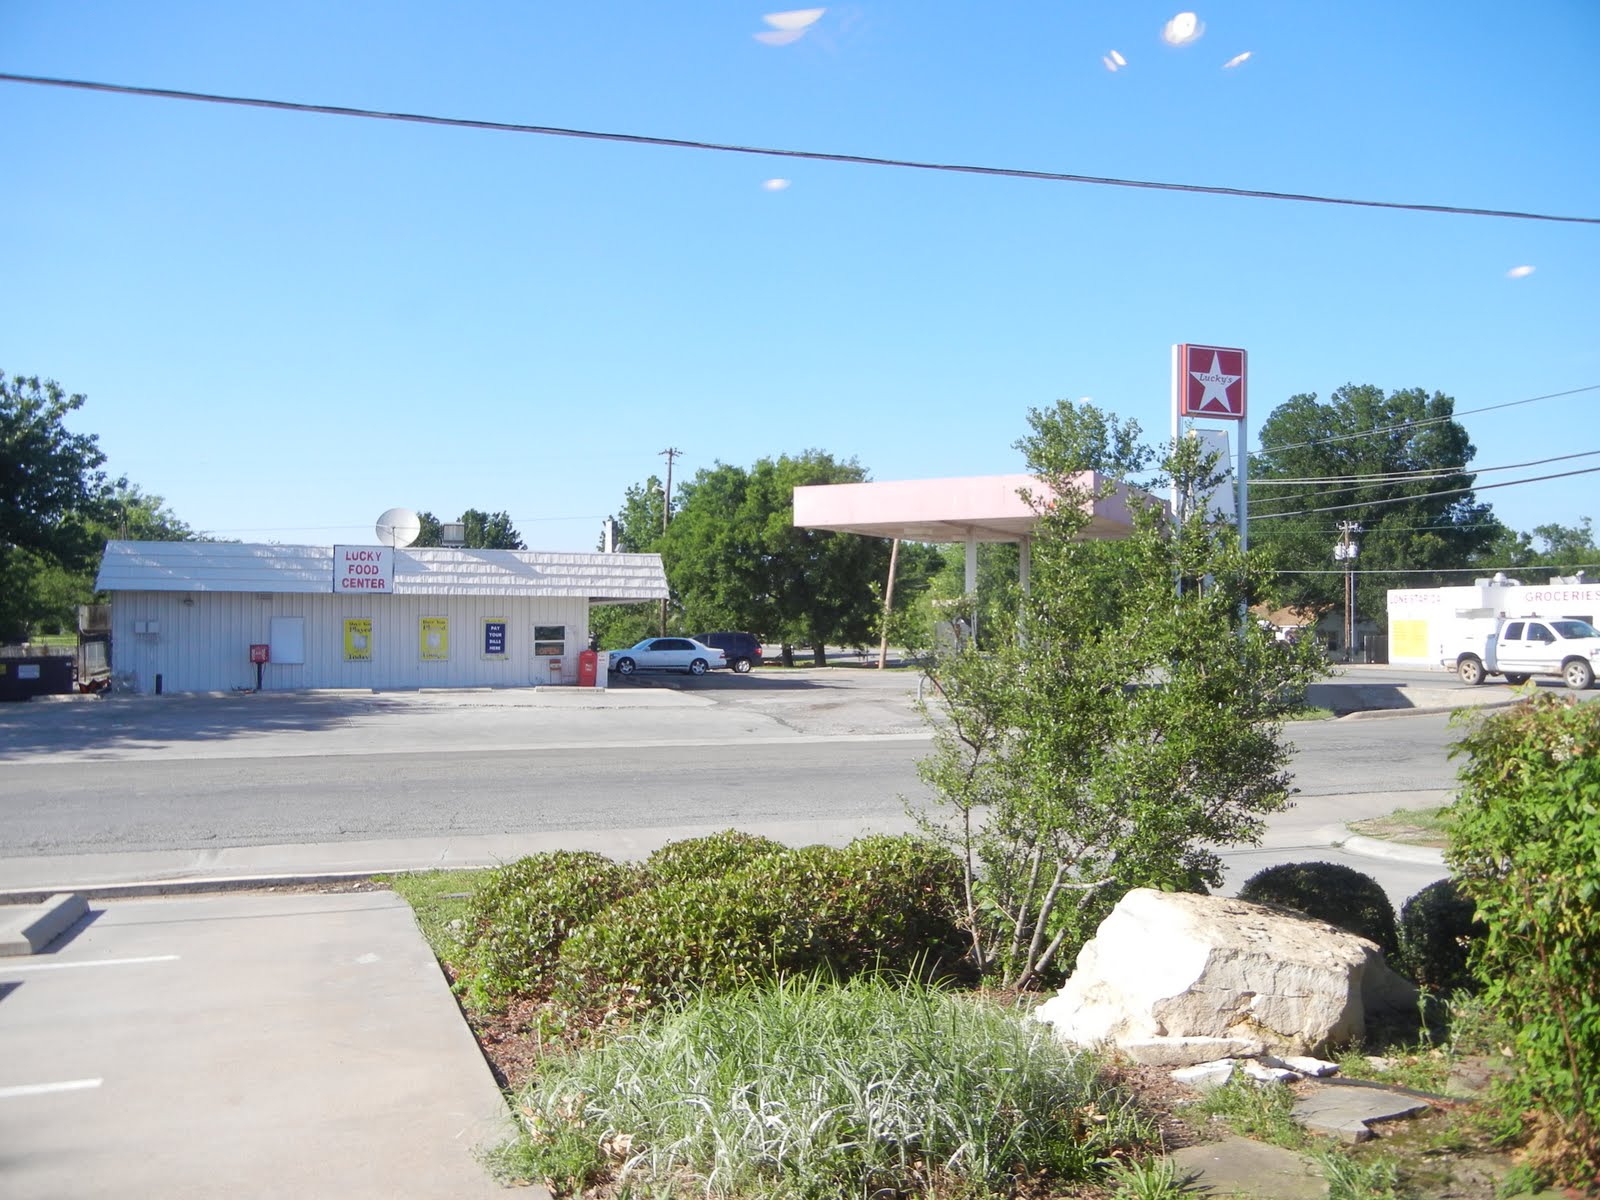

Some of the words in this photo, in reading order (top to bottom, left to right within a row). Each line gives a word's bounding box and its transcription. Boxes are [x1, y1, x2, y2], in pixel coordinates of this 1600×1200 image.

[1200, 373, 1233, 385] Lucky's
[345, 551, 382, 561] LUCKY
[348, 564, 379, 575] FOOD
[341, 577, 385, 589] CENTER
